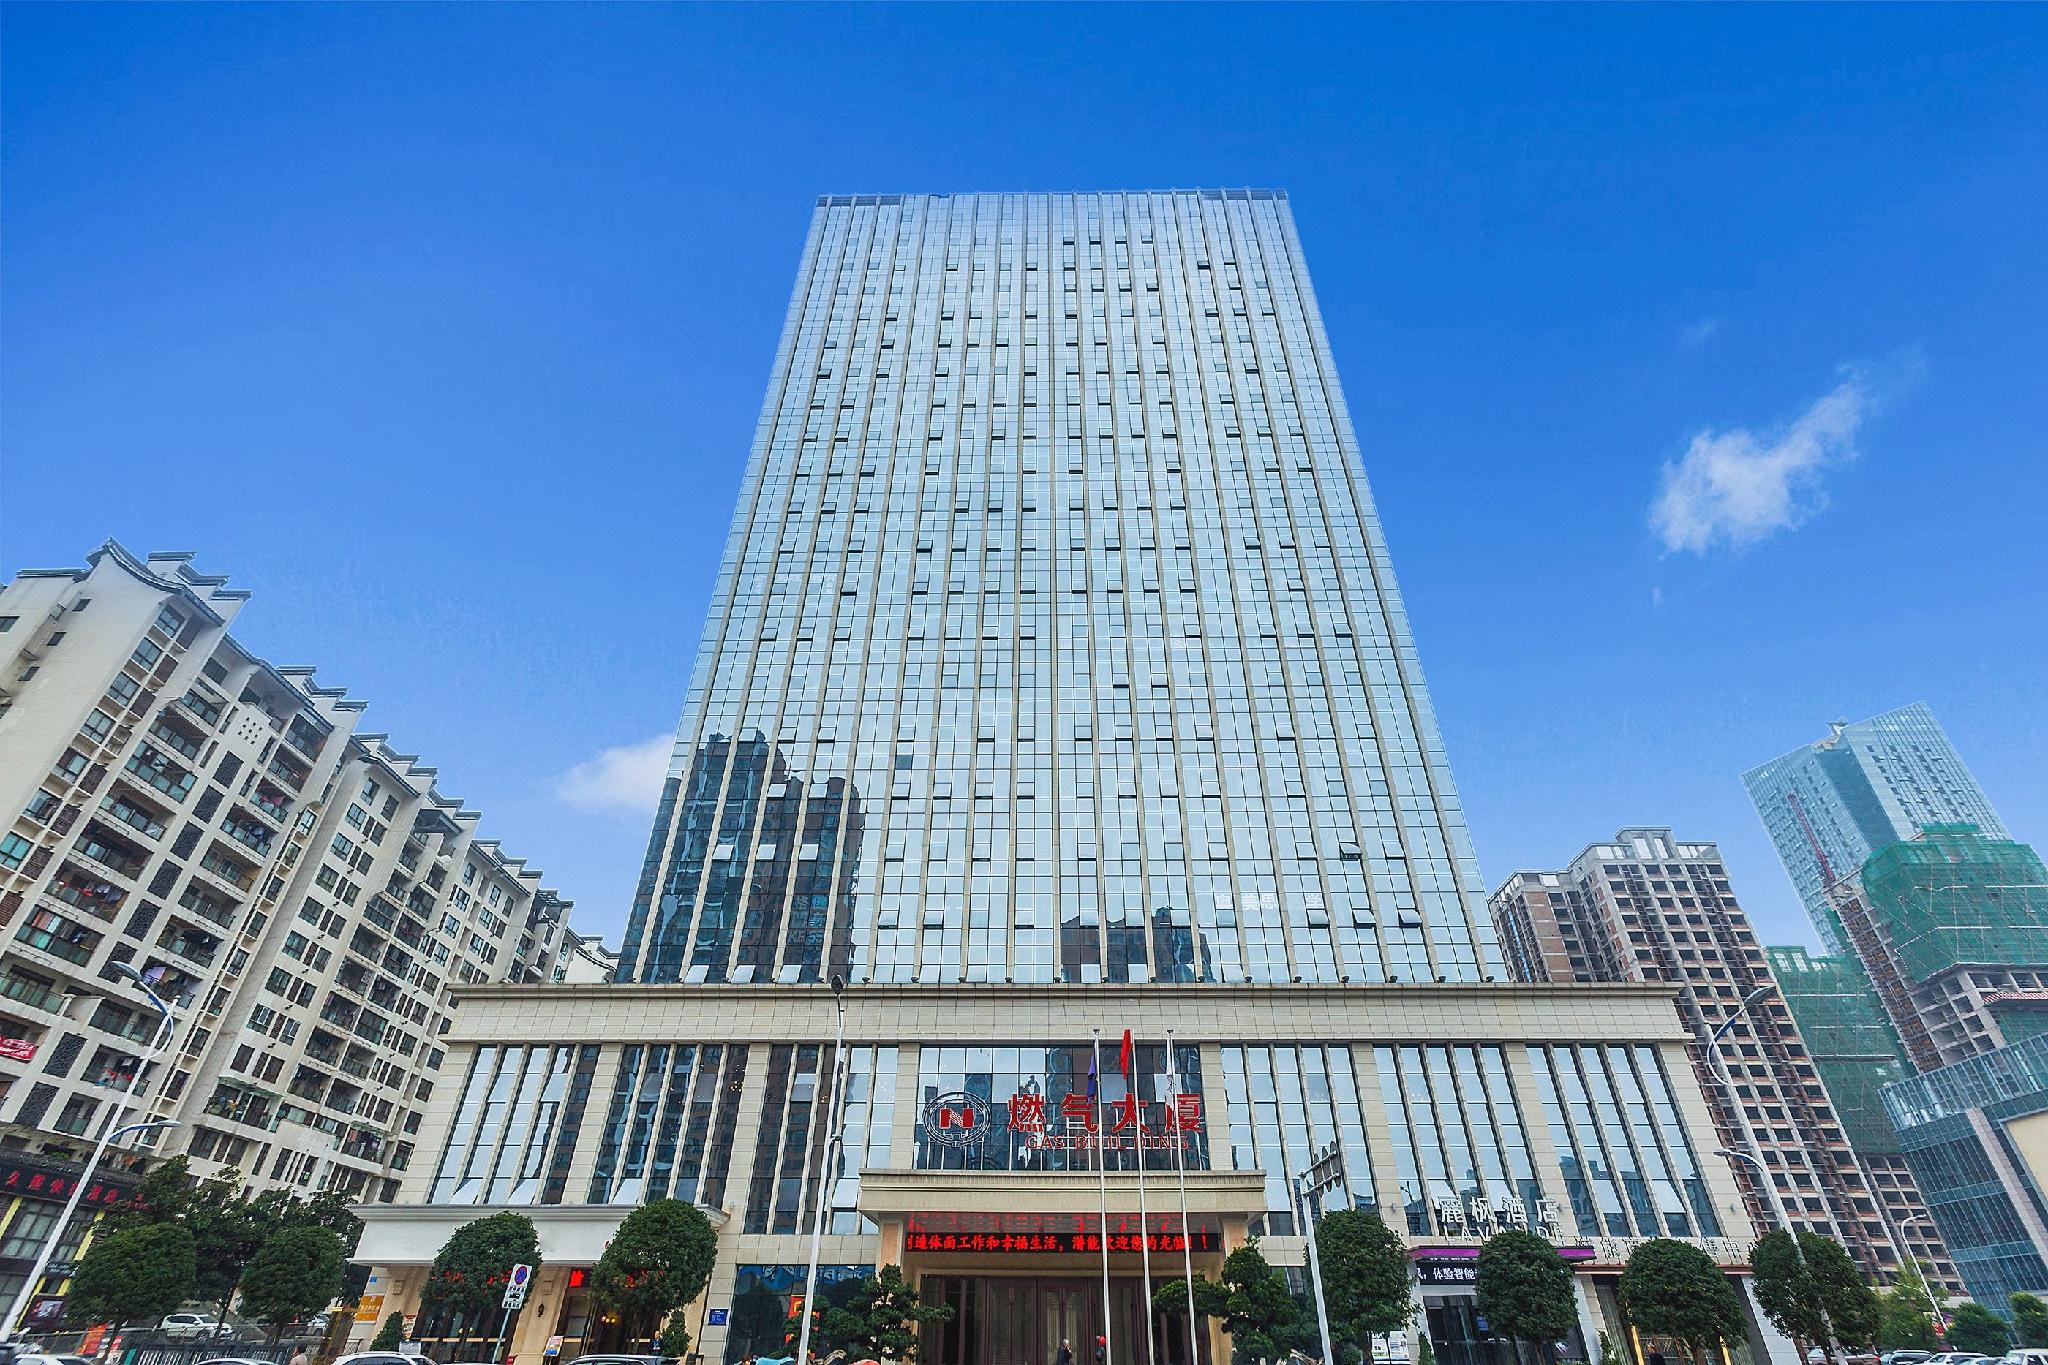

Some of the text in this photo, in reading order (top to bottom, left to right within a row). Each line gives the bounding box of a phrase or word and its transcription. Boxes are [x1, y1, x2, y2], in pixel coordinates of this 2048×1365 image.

[1007, 1093, 1204, 1134] 燃气大厦
[1025, 1134, 1189, 1151] GAS BUILDING
